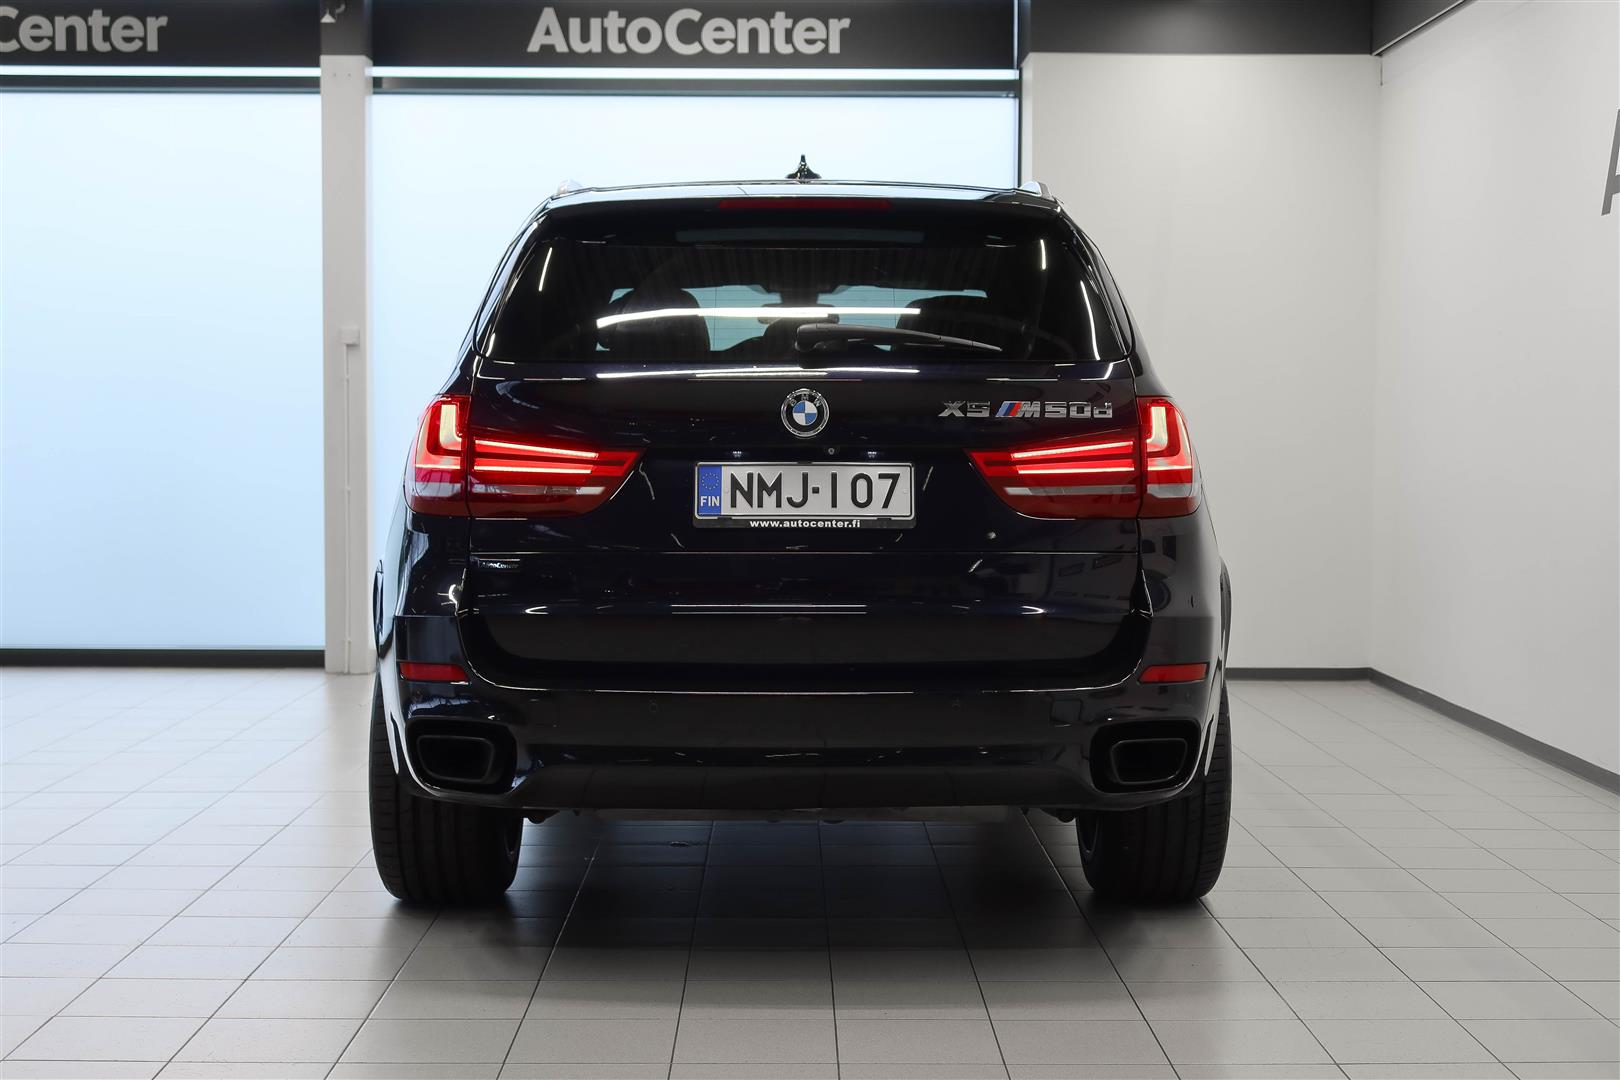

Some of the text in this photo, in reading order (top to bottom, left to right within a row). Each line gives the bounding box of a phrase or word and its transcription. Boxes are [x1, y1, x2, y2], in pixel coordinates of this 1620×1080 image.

[526, 6, 851, 55] AutoCenter
[789, 393, 822, 407] BMW
[938, 400, 991, 418] X5
[729, 471, 901, 509] NMJ-107
[700, 495, 721, 507] FIN
[749, 518, 861, 529] www.autocenter.fi
